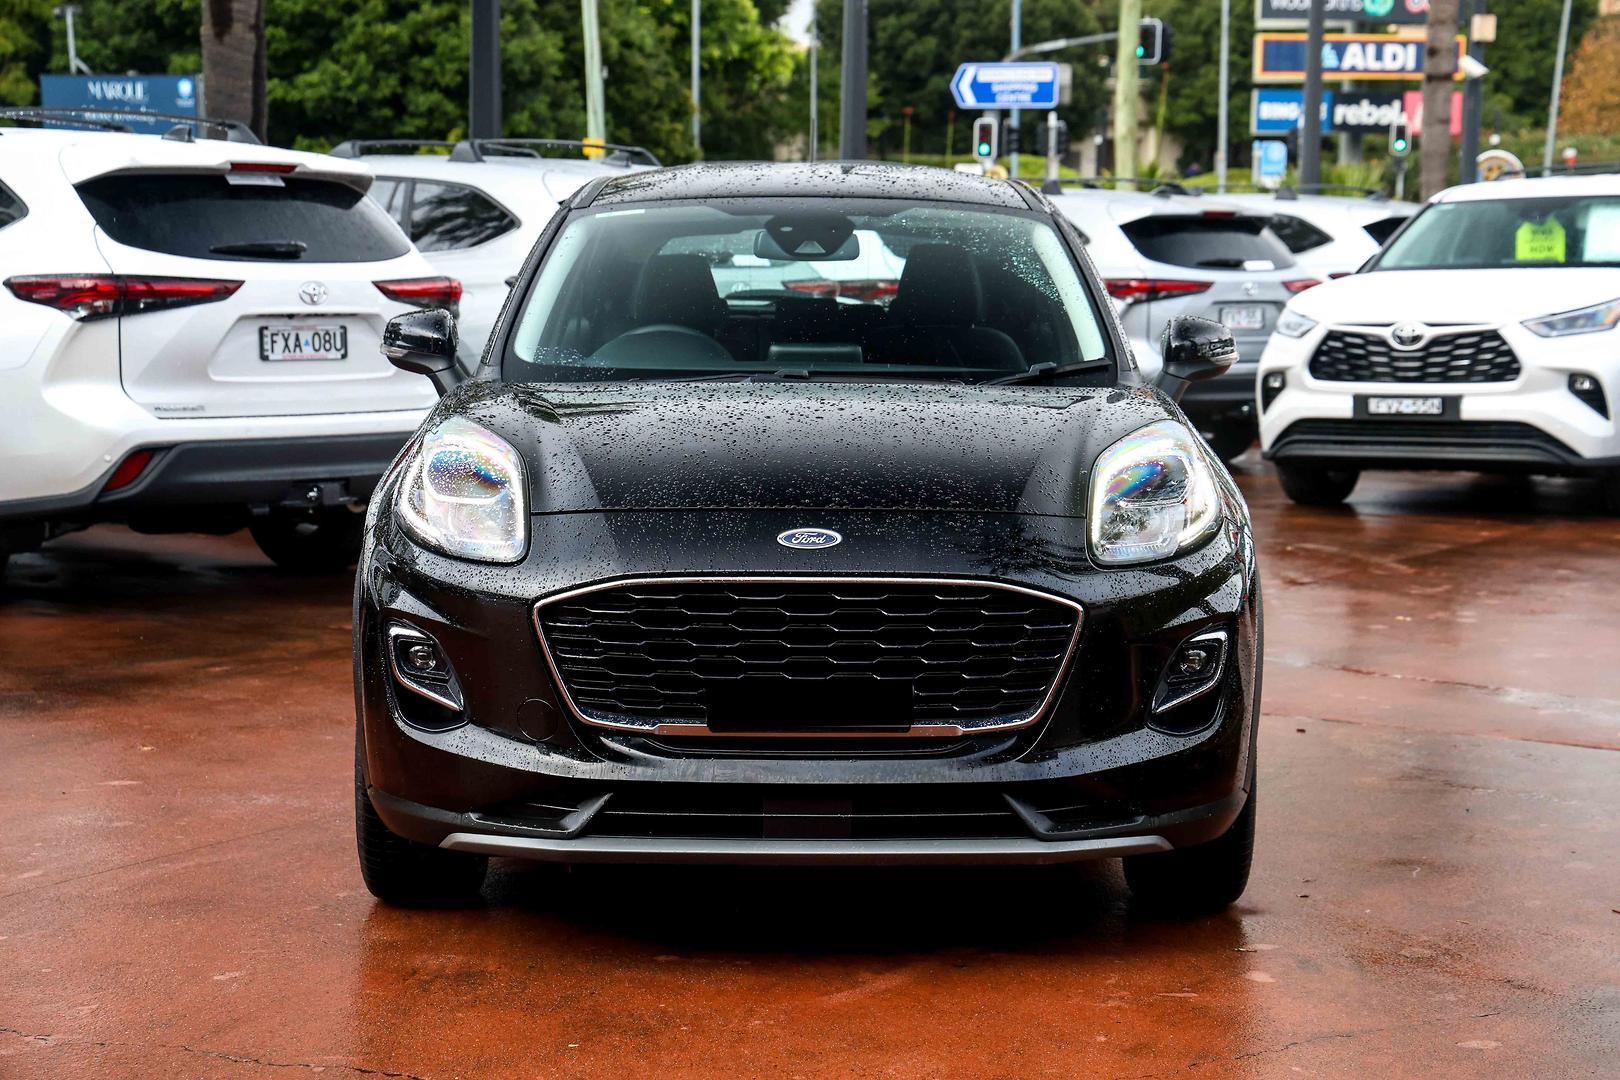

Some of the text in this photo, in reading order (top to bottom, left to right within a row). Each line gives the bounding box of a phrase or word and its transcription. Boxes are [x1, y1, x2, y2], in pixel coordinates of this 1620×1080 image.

[1341, 42, 1417, 71] ALDI
[1333, 99, 1402, 125] rebel
[270, 332, 303, 354] FXA
[791, 532, 826, 544] Ford
